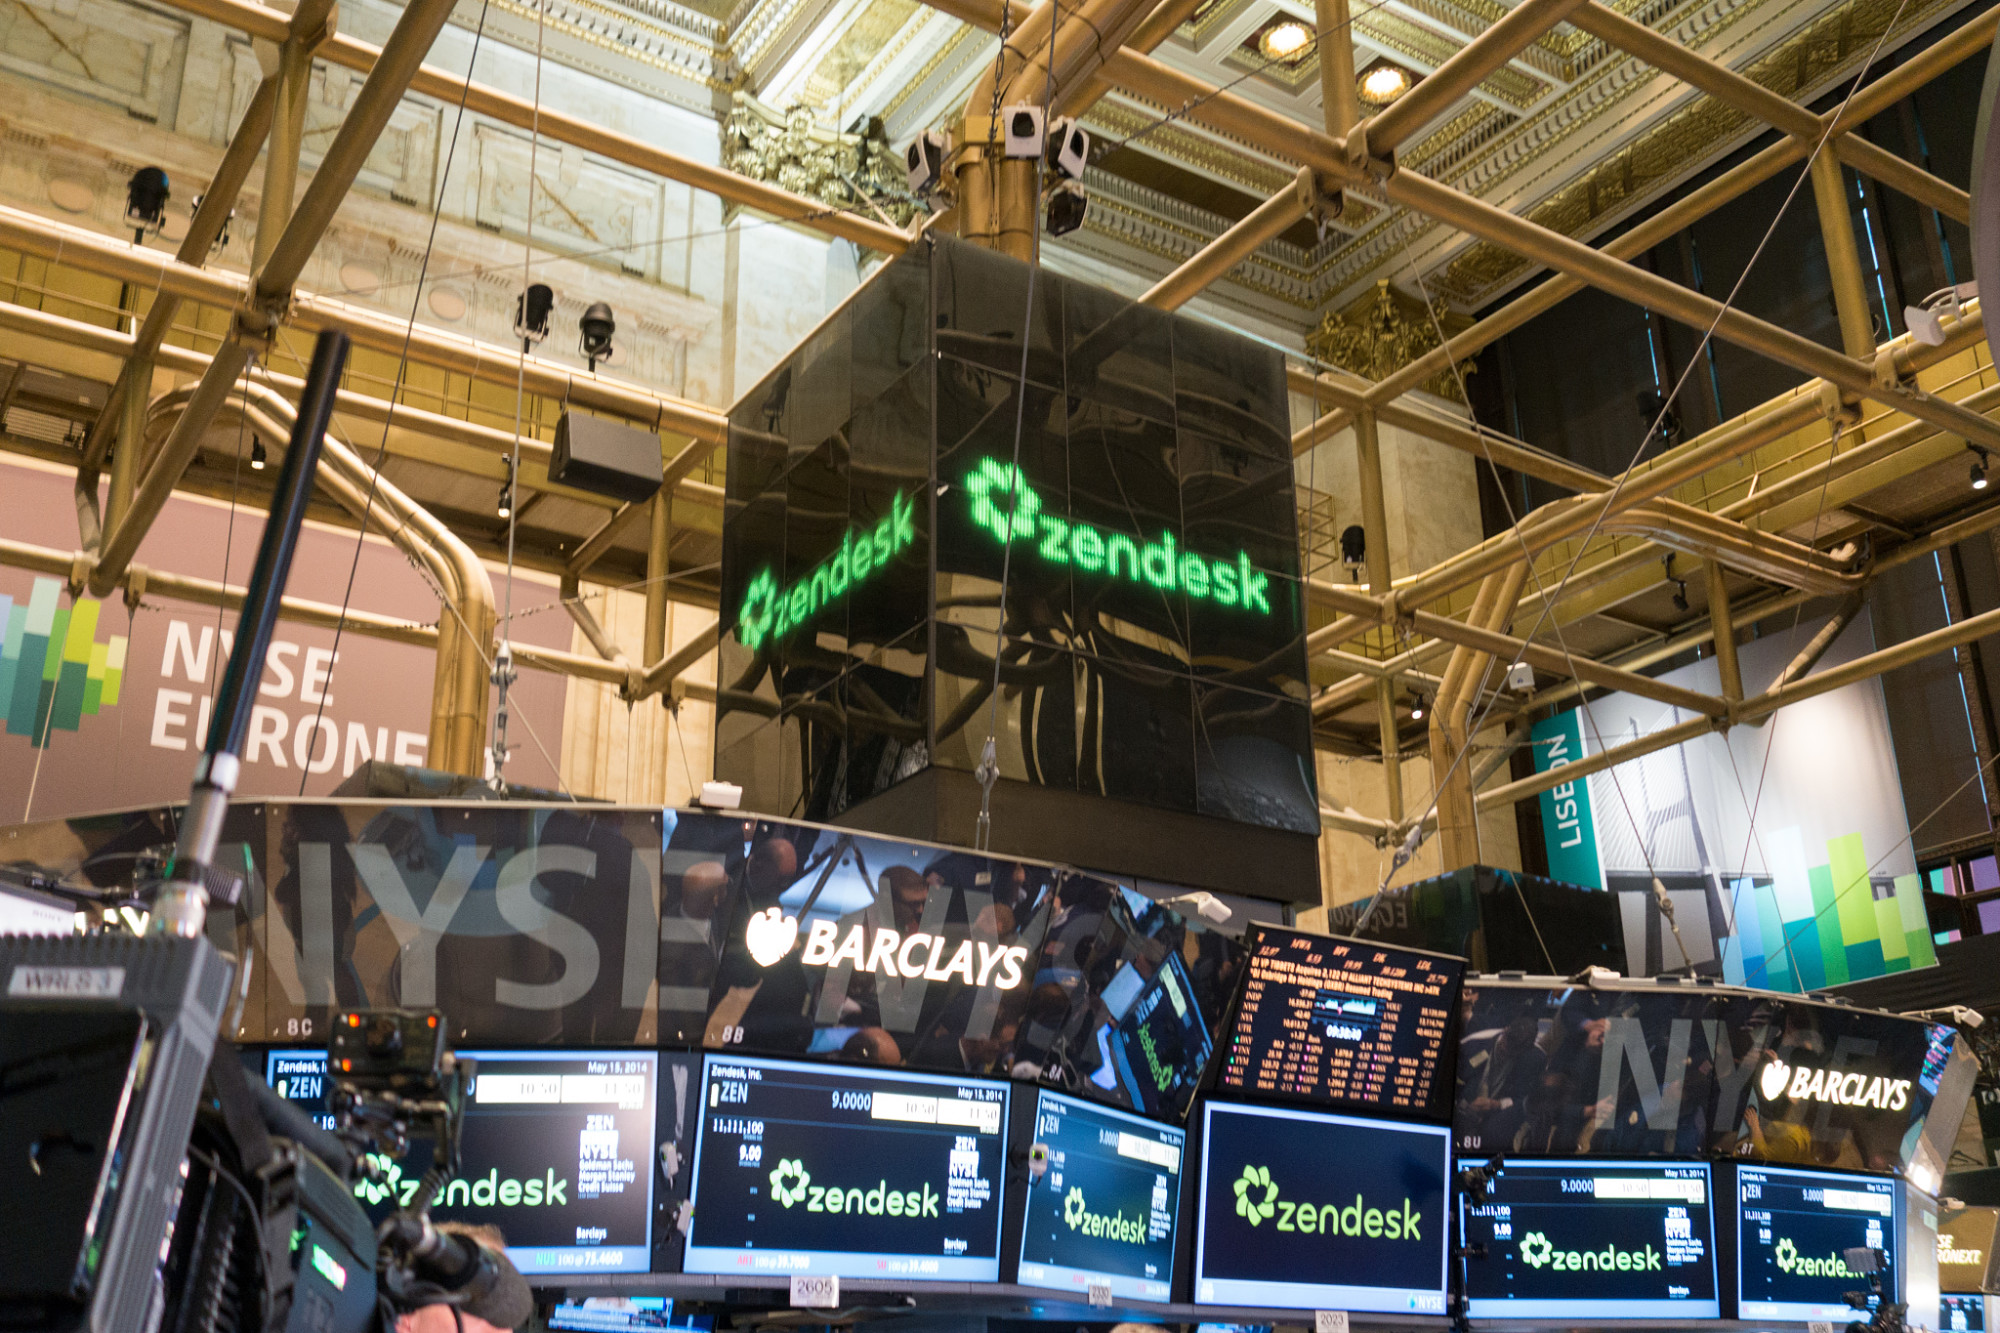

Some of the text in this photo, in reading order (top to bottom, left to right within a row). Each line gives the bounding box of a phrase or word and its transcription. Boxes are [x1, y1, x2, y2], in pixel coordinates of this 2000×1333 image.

[772, 487, 914, 640] zendesk
[1040, 513, 1271, 615] zendesk
[160, 620, 339, 707] NSE
[150, 687, 511, 782] ERONE
[802, 918, 1028, 990] BARCLAYS
[287, 1018, 313, 1037] 8C
[722, 1025, 744, 1044] 8B
[277, 1060, 319, 1075] Zendesk,
[588, 1061, 607, 1075] May
[712, 1064, 747, 1080] Zendesk,
[289, 1076, 322, 1099] ZEN
[720, 1080, 748, 1104] ZEN
[1787, 1066, 1912, 1112] BARCLAYS
[832, 1090, 871, 1111] 9.0000
[1045, 1113, 1060, 1135] ZEN
[739, 1144, 762, 1161] 9.00
[1463, 1135, 1481, 1149] 8U
[400, 1167, 567, 1206] zndesk
[1561, 1178, 1594, 1193] 9.0000
[1747, 1184, 1762, 1200] ZEN
[807, 1179, 939, 1218] zendesk
[1082, 1208, 1146, 1245] zendesk
[1277, 1193, 1421, 1241] zendesk
[576, 1226, 607, 1241] Barclays
[1552, 1243, 1661, 1271] zendesk
[1796, 1251, 1865, 1278] zende
[796, 1280, 833, 1296] 2605
[1417, 1294, 1443, 1310] NYSE
[1320, 1313, 1345, 1326] 2023
